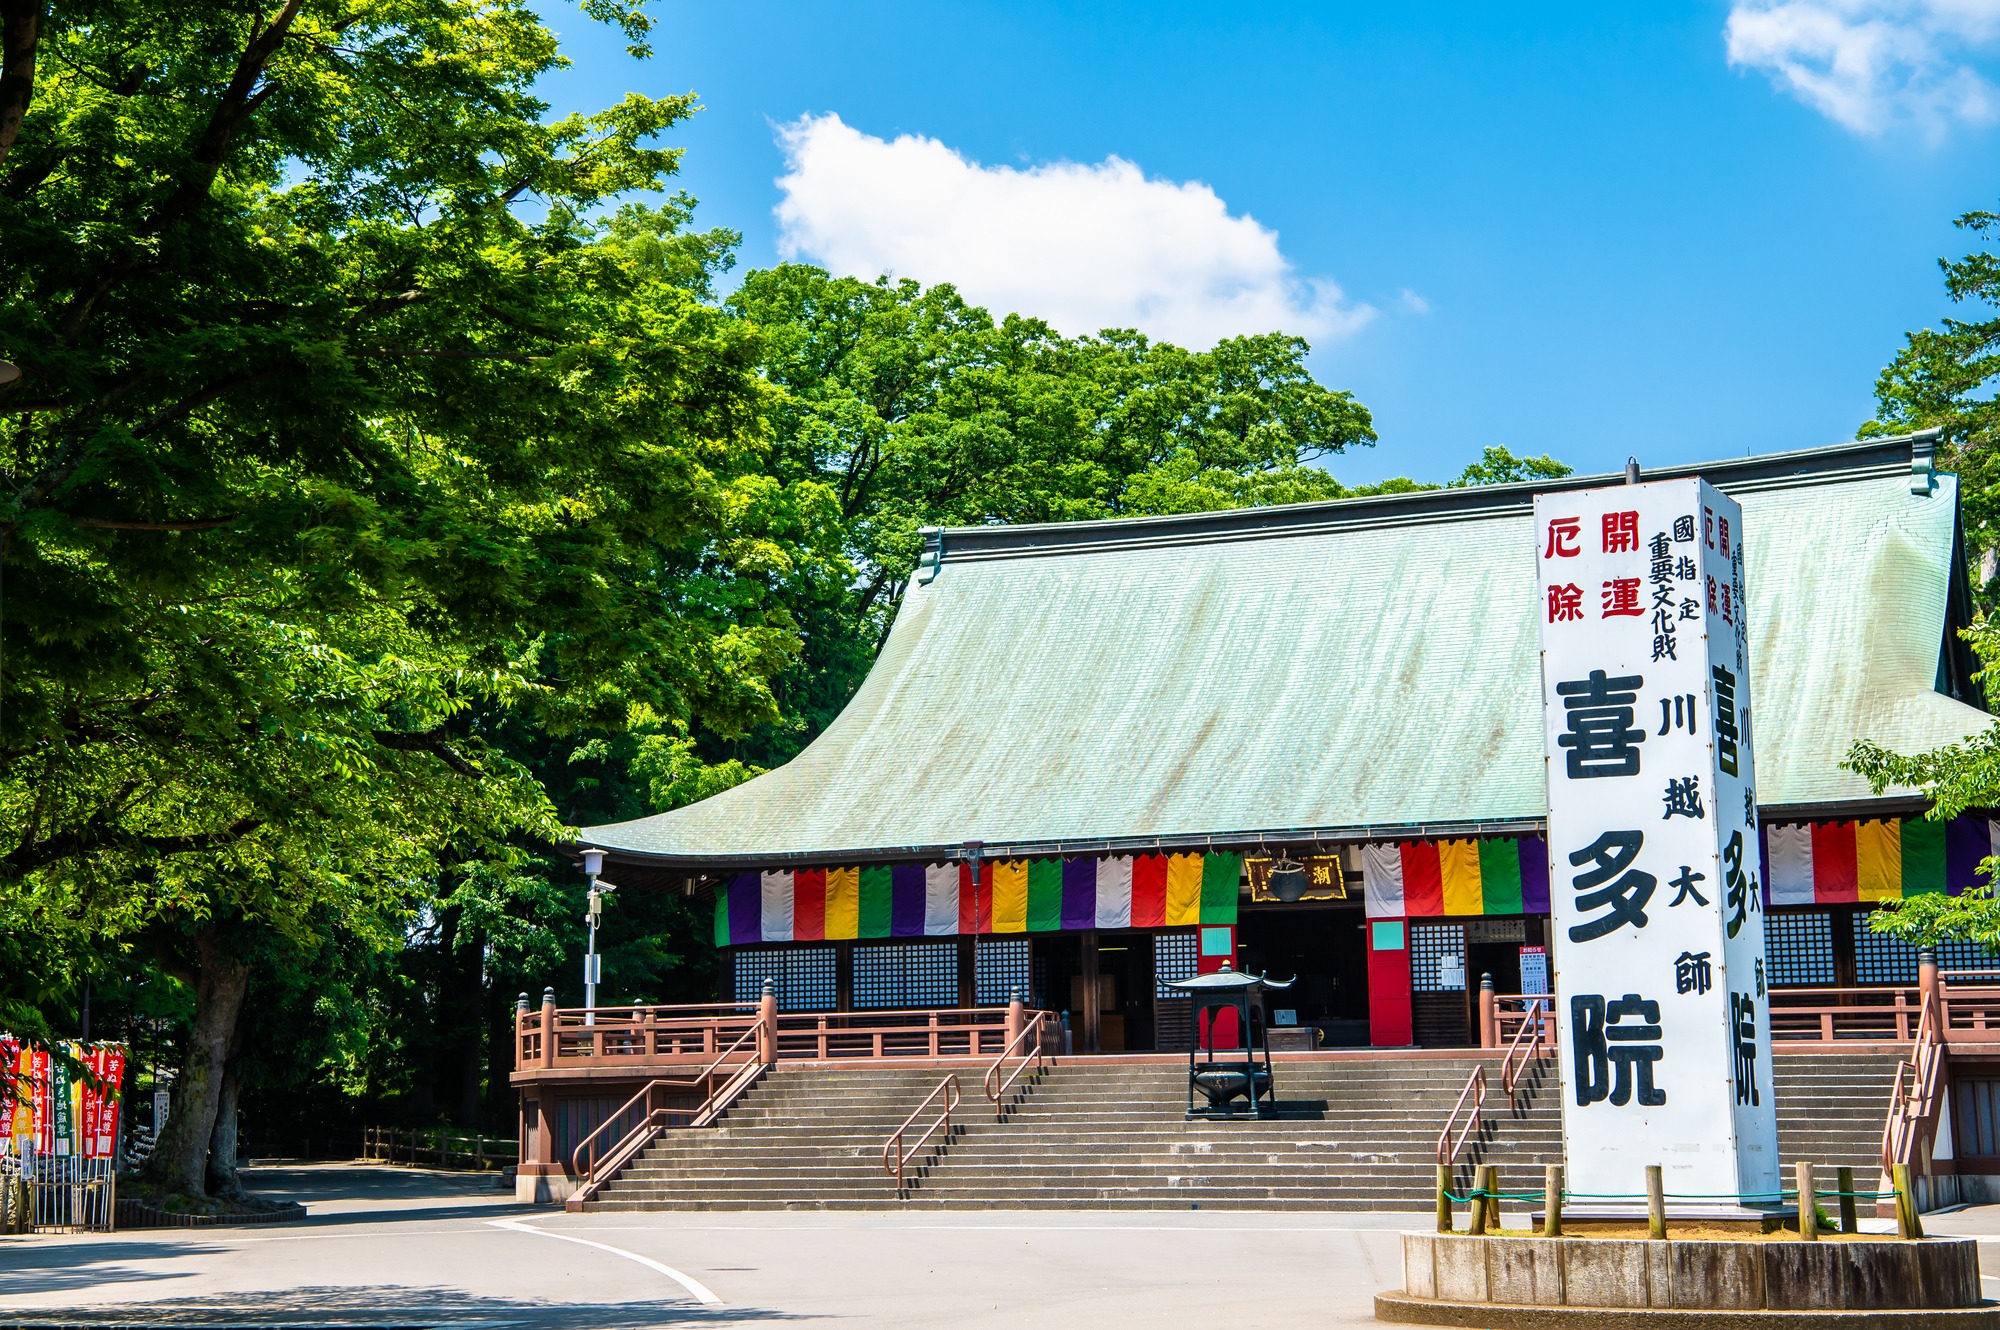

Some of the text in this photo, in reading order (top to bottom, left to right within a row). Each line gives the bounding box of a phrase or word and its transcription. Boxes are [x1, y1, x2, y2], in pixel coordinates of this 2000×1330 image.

[1544, 516, 1585, 624] 厄除
[1600, 509, 1647, 620] 開運
[1672, 514, 1701, 622] 國指定
[1703, 505, 1719, 617] 厄除
[1556, 669, 1667, 1107] 喜多院
[1657, 693, 1712, 996] 川越大師
[1712, 664, 1760, 1107] 喜多院
